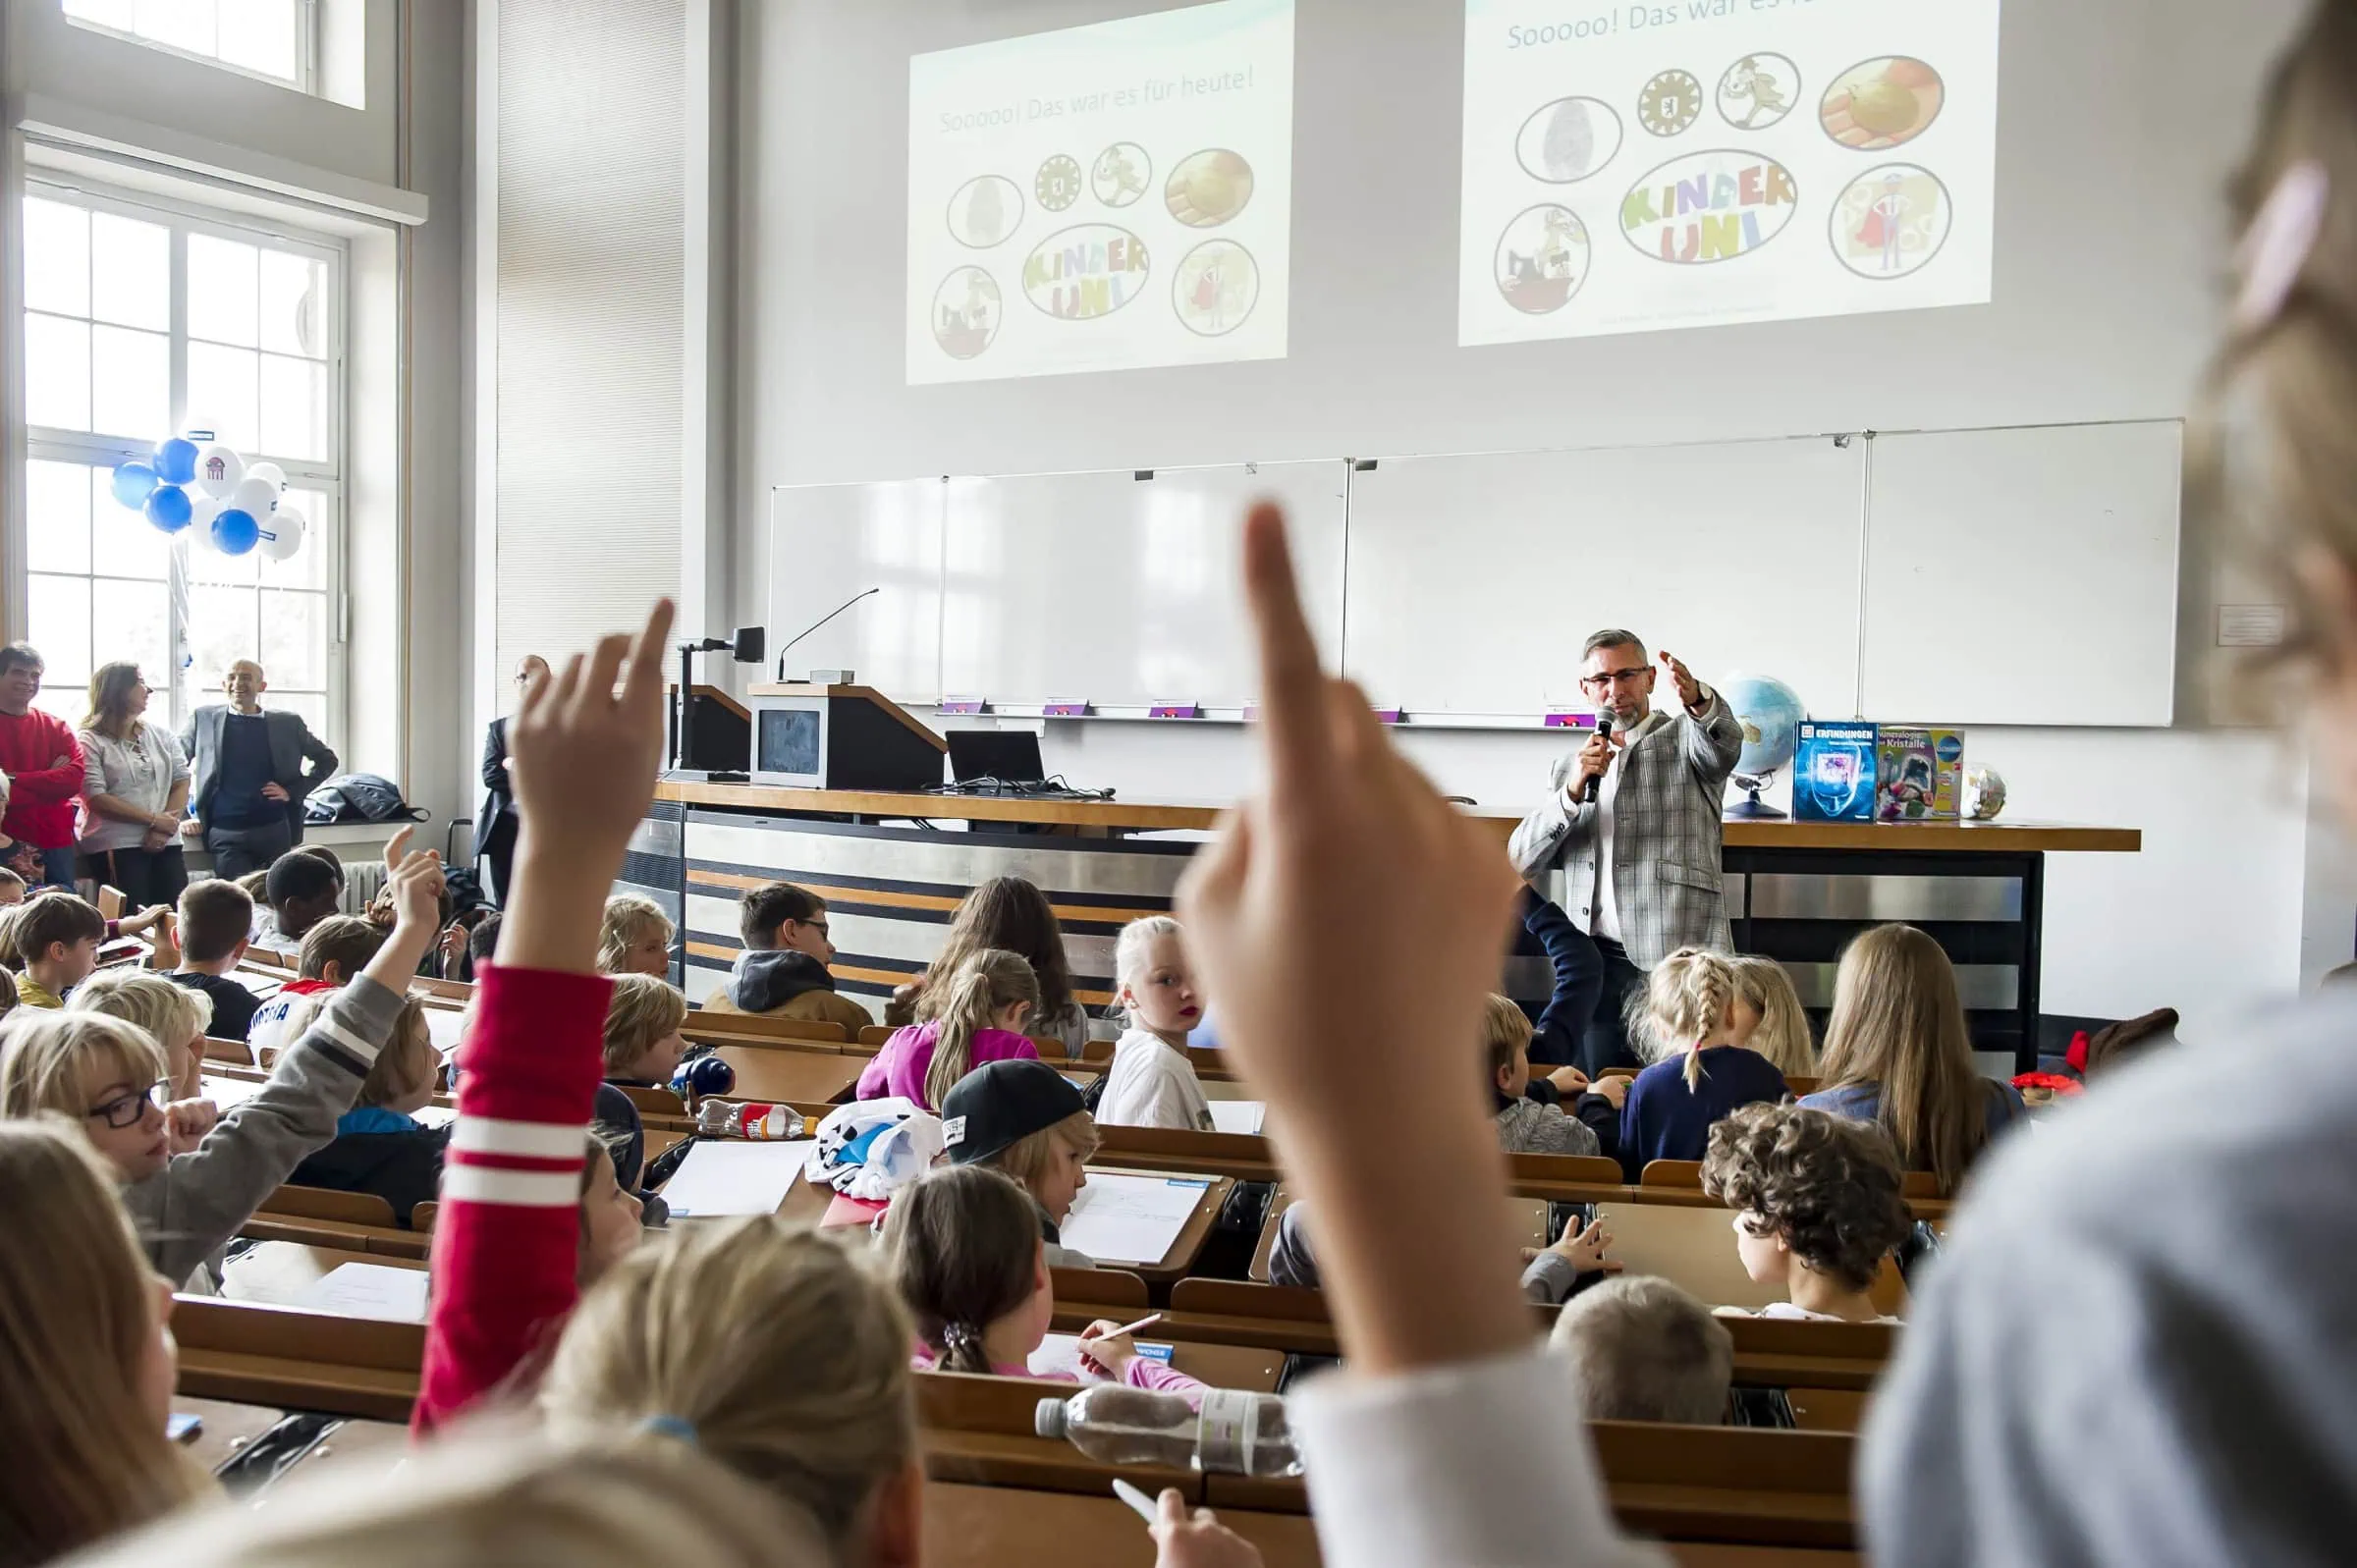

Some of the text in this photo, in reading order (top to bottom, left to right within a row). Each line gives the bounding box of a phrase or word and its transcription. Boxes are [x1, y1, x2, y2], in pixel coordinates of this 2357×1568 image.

[1507, 7, 1618, 50] Sooooo!
[1629, 4, 1678, 30] Das
[1686, 0, 1736, 20] war
[939, 62, 1254, 134] Sooooo! Das war es für heute!
[1620, 163, 1795, 231] KINDER
[1661, 210, 1761, 262] UNI
[1024, 237, 1148, 291] KINDER
[1052, 274, 1124, 318] UNI
[1815, 729, 1874, 739] ERFINDUNGEN
